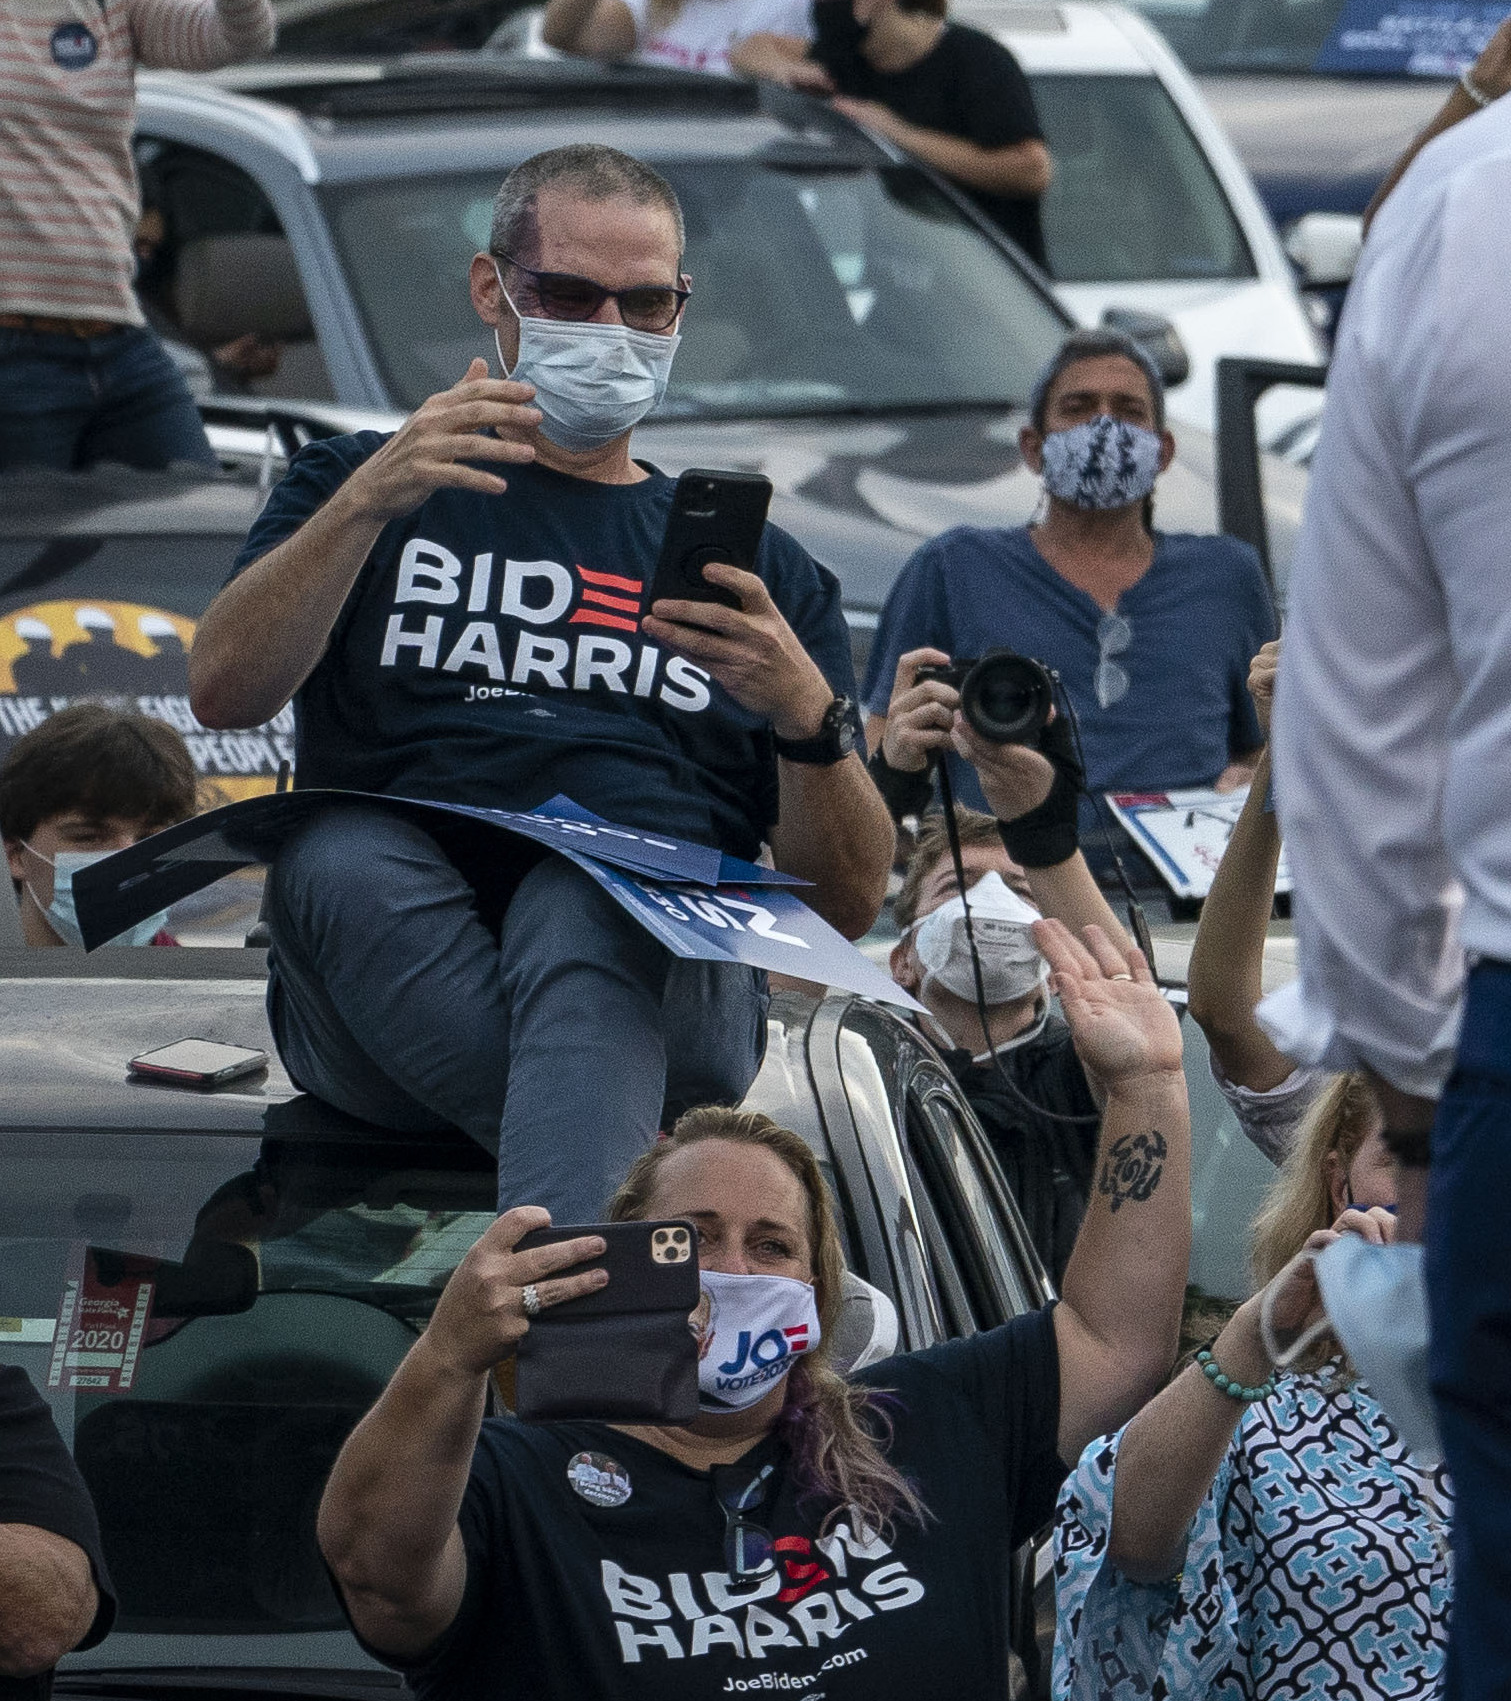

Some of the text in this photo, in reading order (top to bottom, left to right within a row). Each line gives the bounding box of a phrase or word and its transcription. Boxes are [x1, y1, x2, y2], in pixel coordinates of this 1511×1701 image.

[394, 538, 643, 633] BIDE
[379, 613, 712, 712] HARRIS
[71, 1330, 125, 1349] 2020
[601, 1522, 893, 1620] BIDEN
[616, 1561, 926, 1663] HARRIS
